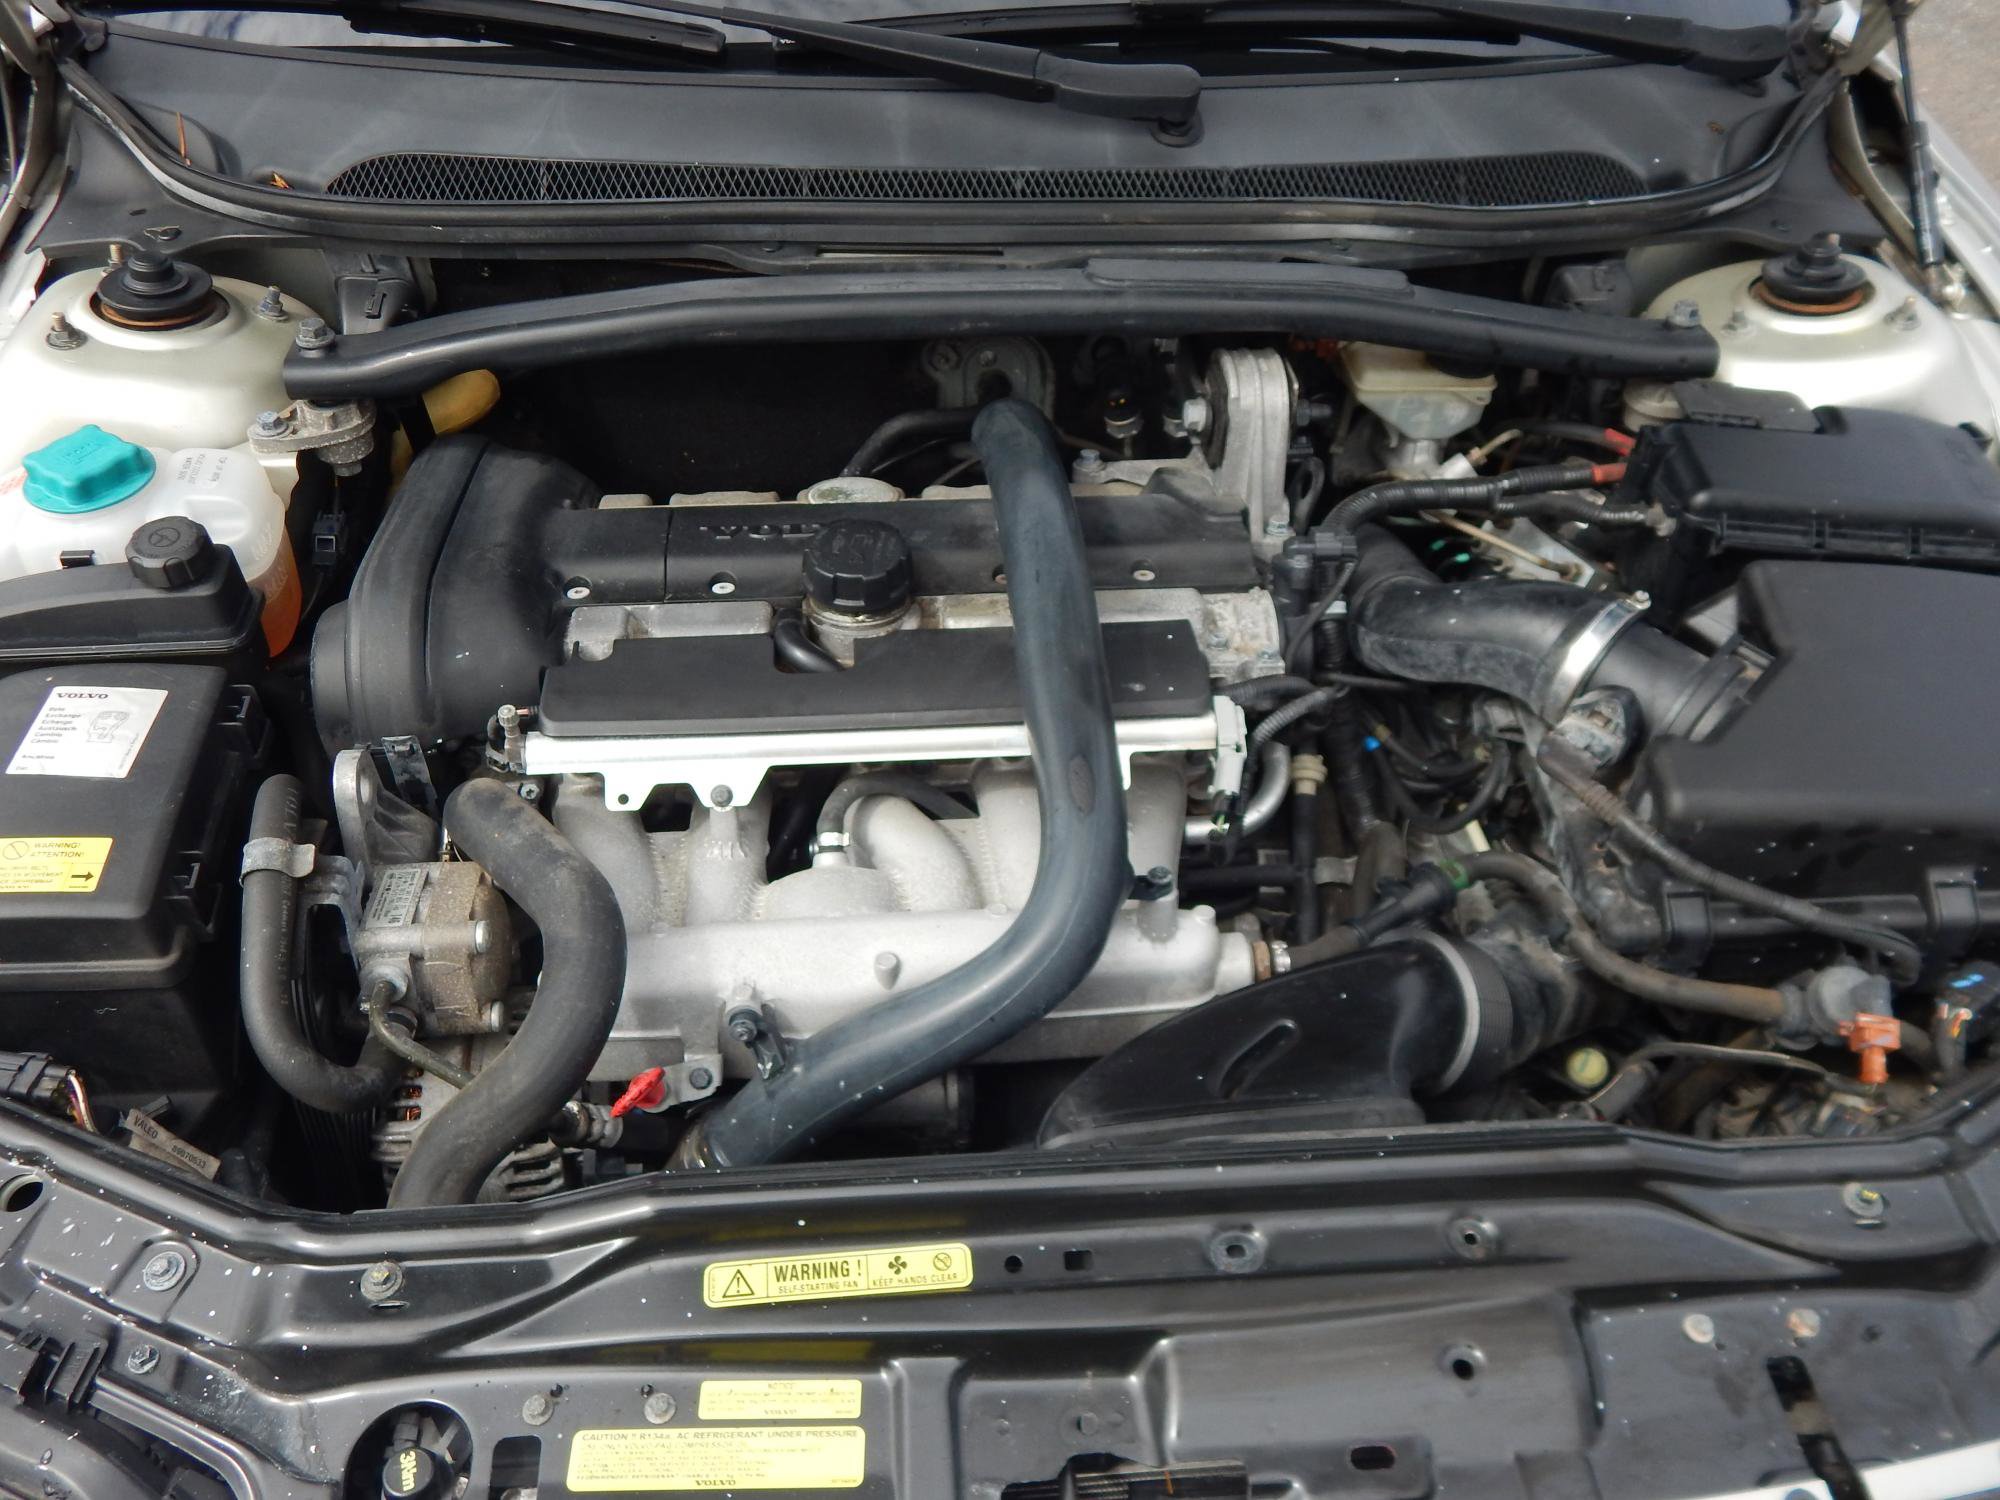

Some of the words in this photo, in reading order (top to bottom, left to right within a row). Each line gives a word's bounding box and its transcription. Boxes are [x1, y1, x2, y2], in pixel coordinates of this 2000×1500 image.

[57, 692, 109, 700] VOLVO
[134, 1113, 159, 1140] VALEO
[774, 1259, 850, 1283] WARNING
[778, 1281, 840, 1295] SELF-STARTING
[842, 1279, 859, 1289] FAN
[872, 1276, 894, 1287] KEEP
[896, 1274, 928, 1285] HANDS
[930, 1272, 958, 1283] CLEAR
[582, 1433, 628, 1441] CAUTION
[676, 1432, 690, 1440] AC
[693, 1430, 763, 1440] REFRIGERANT
[767, 1430, 802, 1439] UNDER
[805, 1429, 858, 1438] PRESSURE
[694, 1479, 737, 1487] VOLVO
